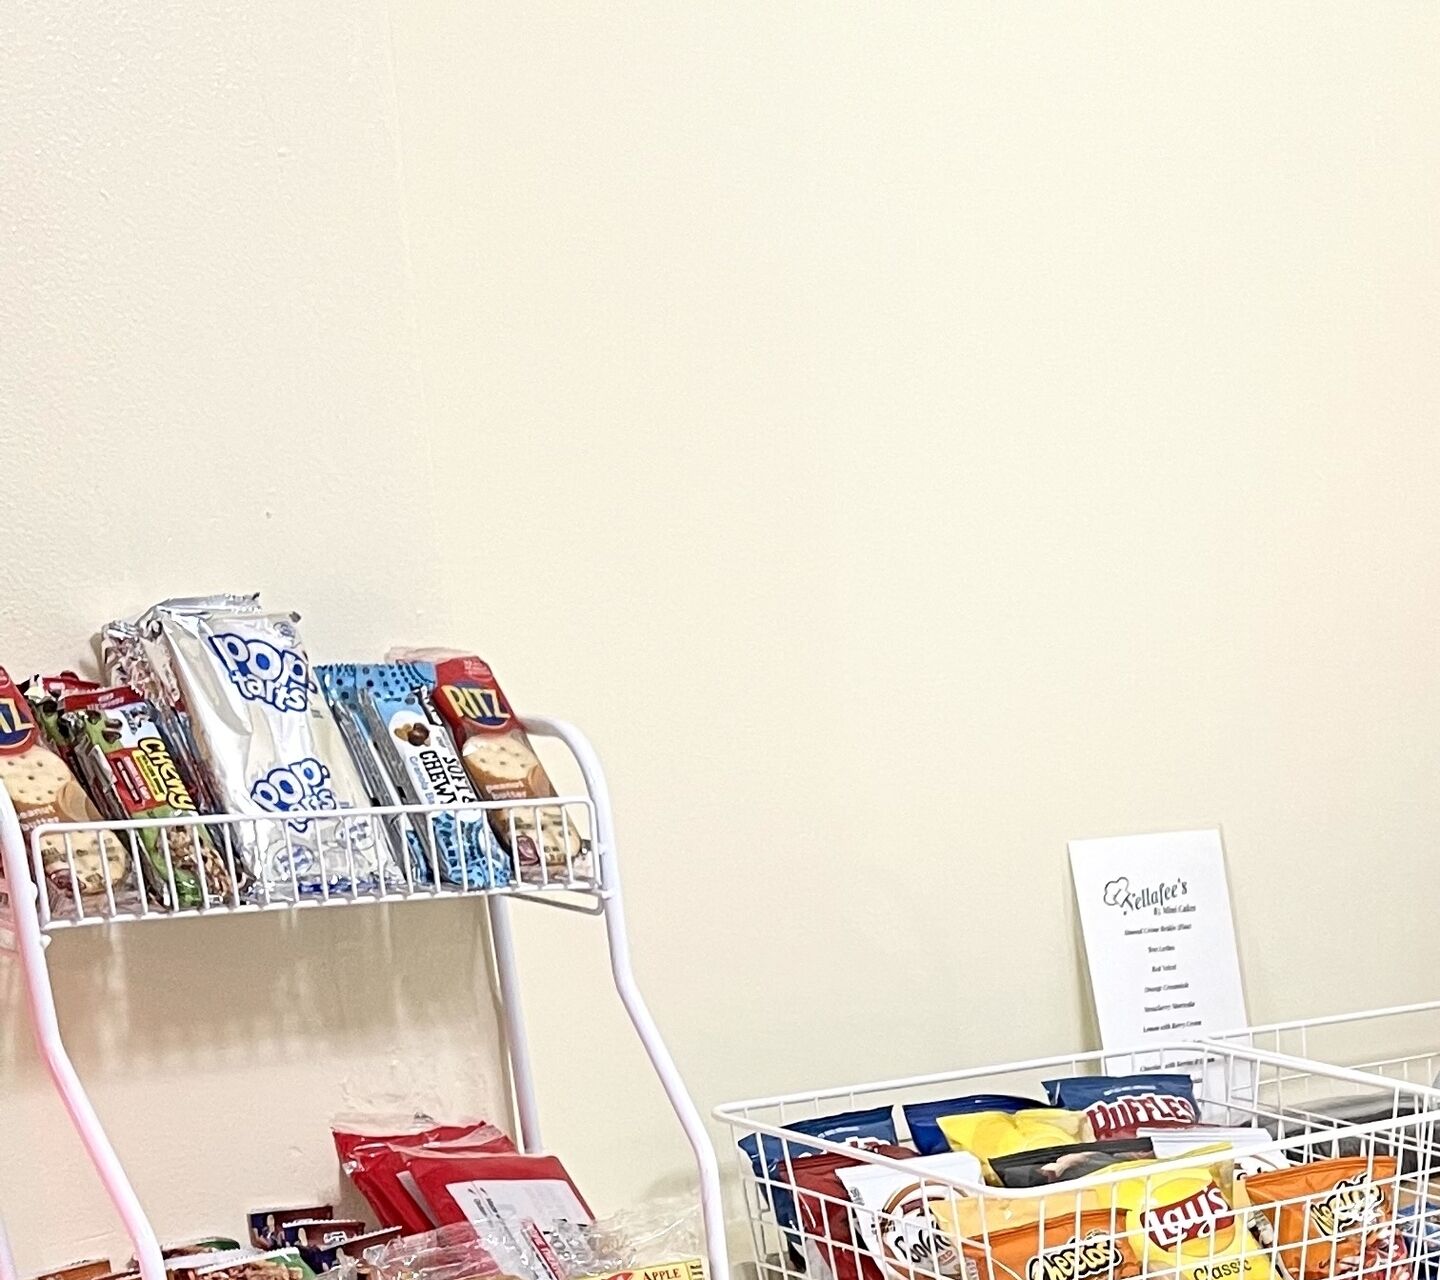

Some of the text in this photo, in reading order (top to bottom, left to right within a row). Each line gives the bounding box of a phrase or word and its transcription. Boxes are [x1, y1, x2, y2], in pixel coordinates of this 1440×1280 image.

[441, 685, 511, 718] RITZ
[1087, 1096, 1196, 1138] RUFFLES
[1145, 1187, 1229, 1246] Lay's
